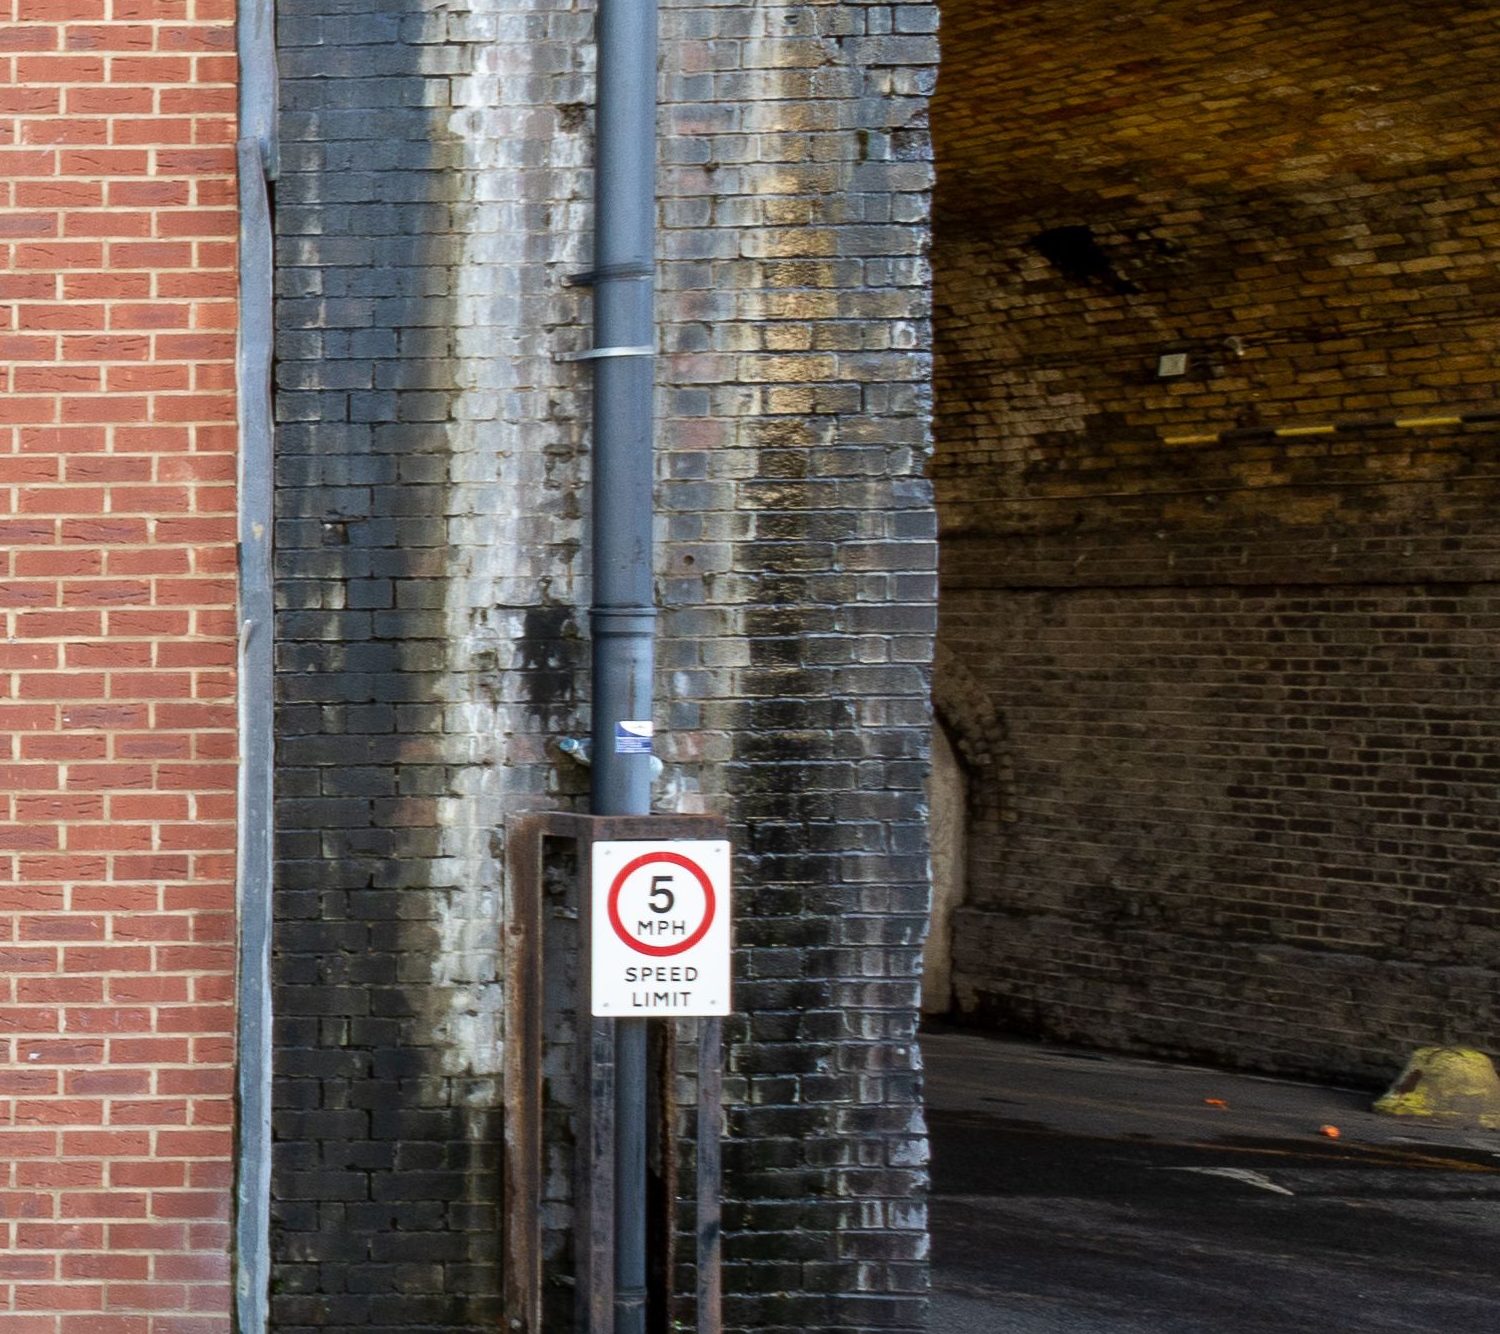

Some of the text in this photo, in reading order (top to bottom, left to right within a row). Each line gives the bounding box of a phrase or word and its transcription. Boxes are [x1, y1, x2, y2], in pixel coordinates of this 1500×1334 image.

[647, 875, 675, 914] 5
[637, 920, 686, 936] MPH
[624, 966, 699, 983] SPEED
[632, 991, 692, 1008] LIMIT
